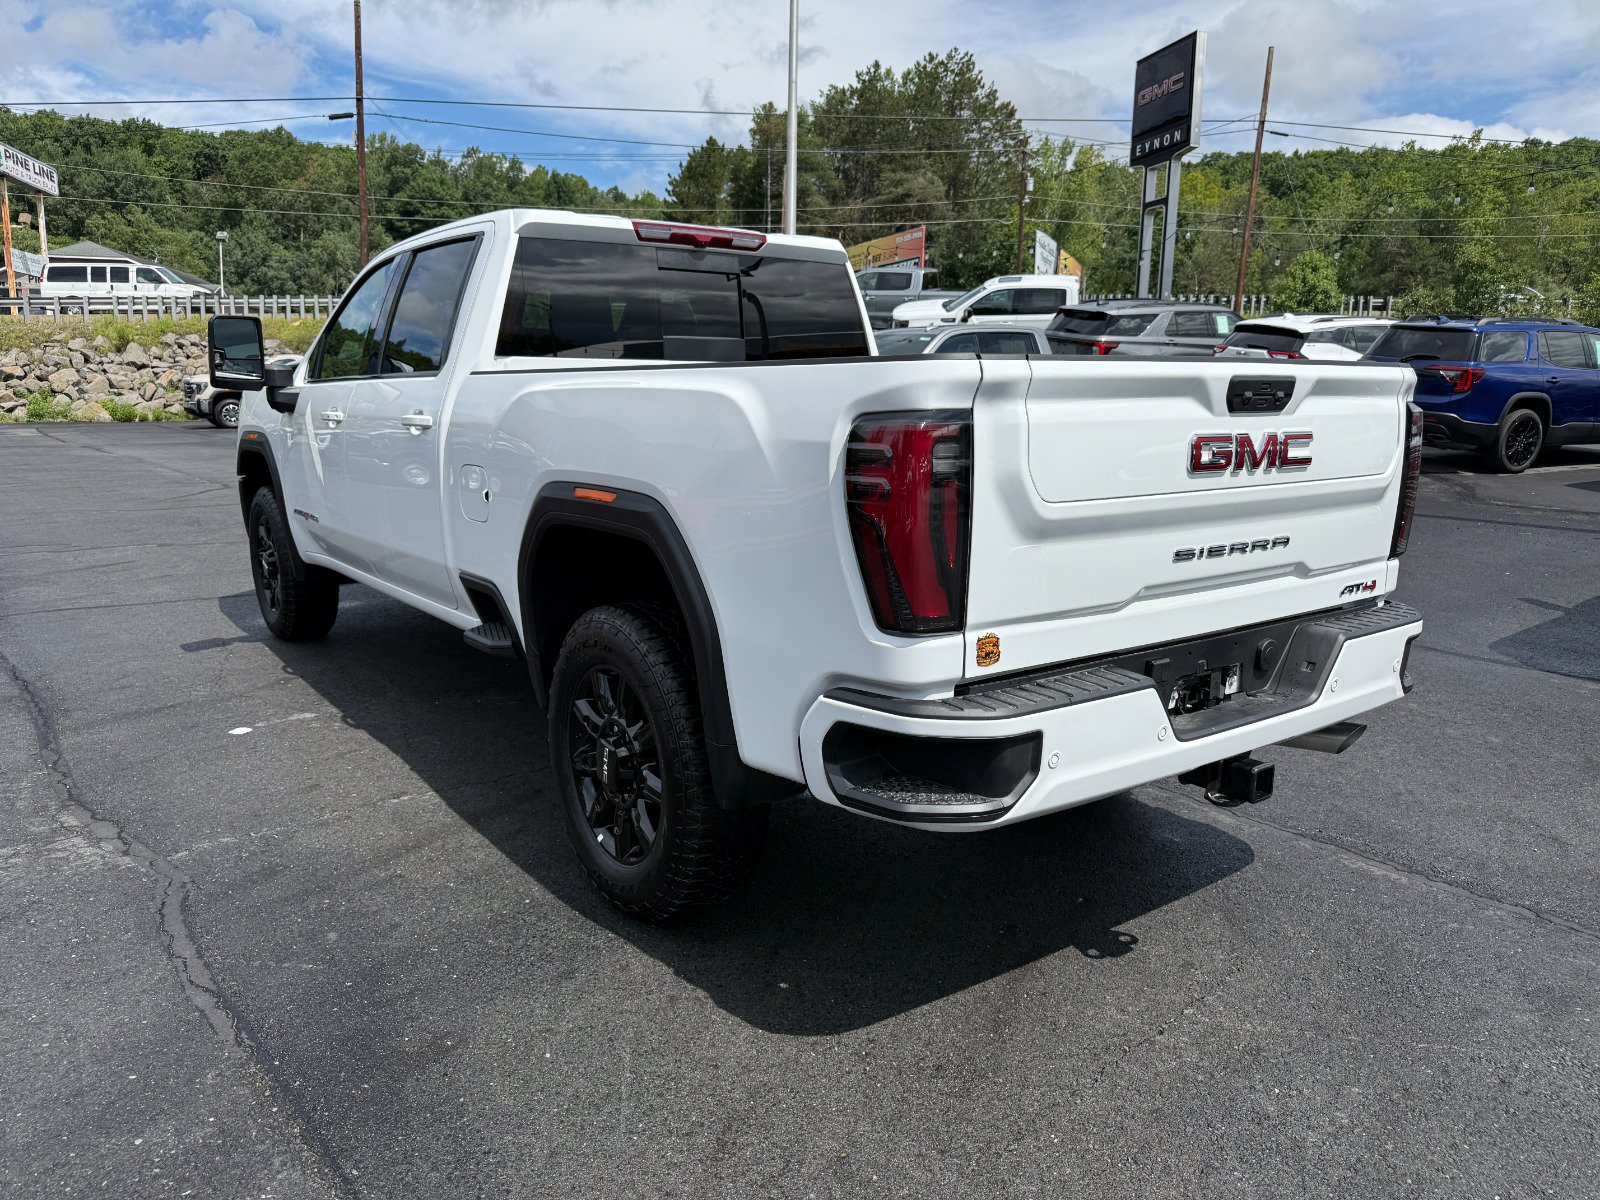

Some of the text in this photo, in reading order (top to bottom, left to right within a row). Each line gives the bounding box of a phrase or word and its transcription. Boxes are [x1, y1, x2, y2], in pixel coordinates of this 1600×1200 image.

[1138, 72, 1184, 106] GMC
[1136, 130, 1181, 156] EYNON
[4, 148, 55, 183] PINE LINE
[5, 164, 19, 176] AUTO
[1187, 431, 1313, 475] GMC
[1172, 535, 1290, 563] SIERRA
[1339, 580, 1377, 597] AT4
